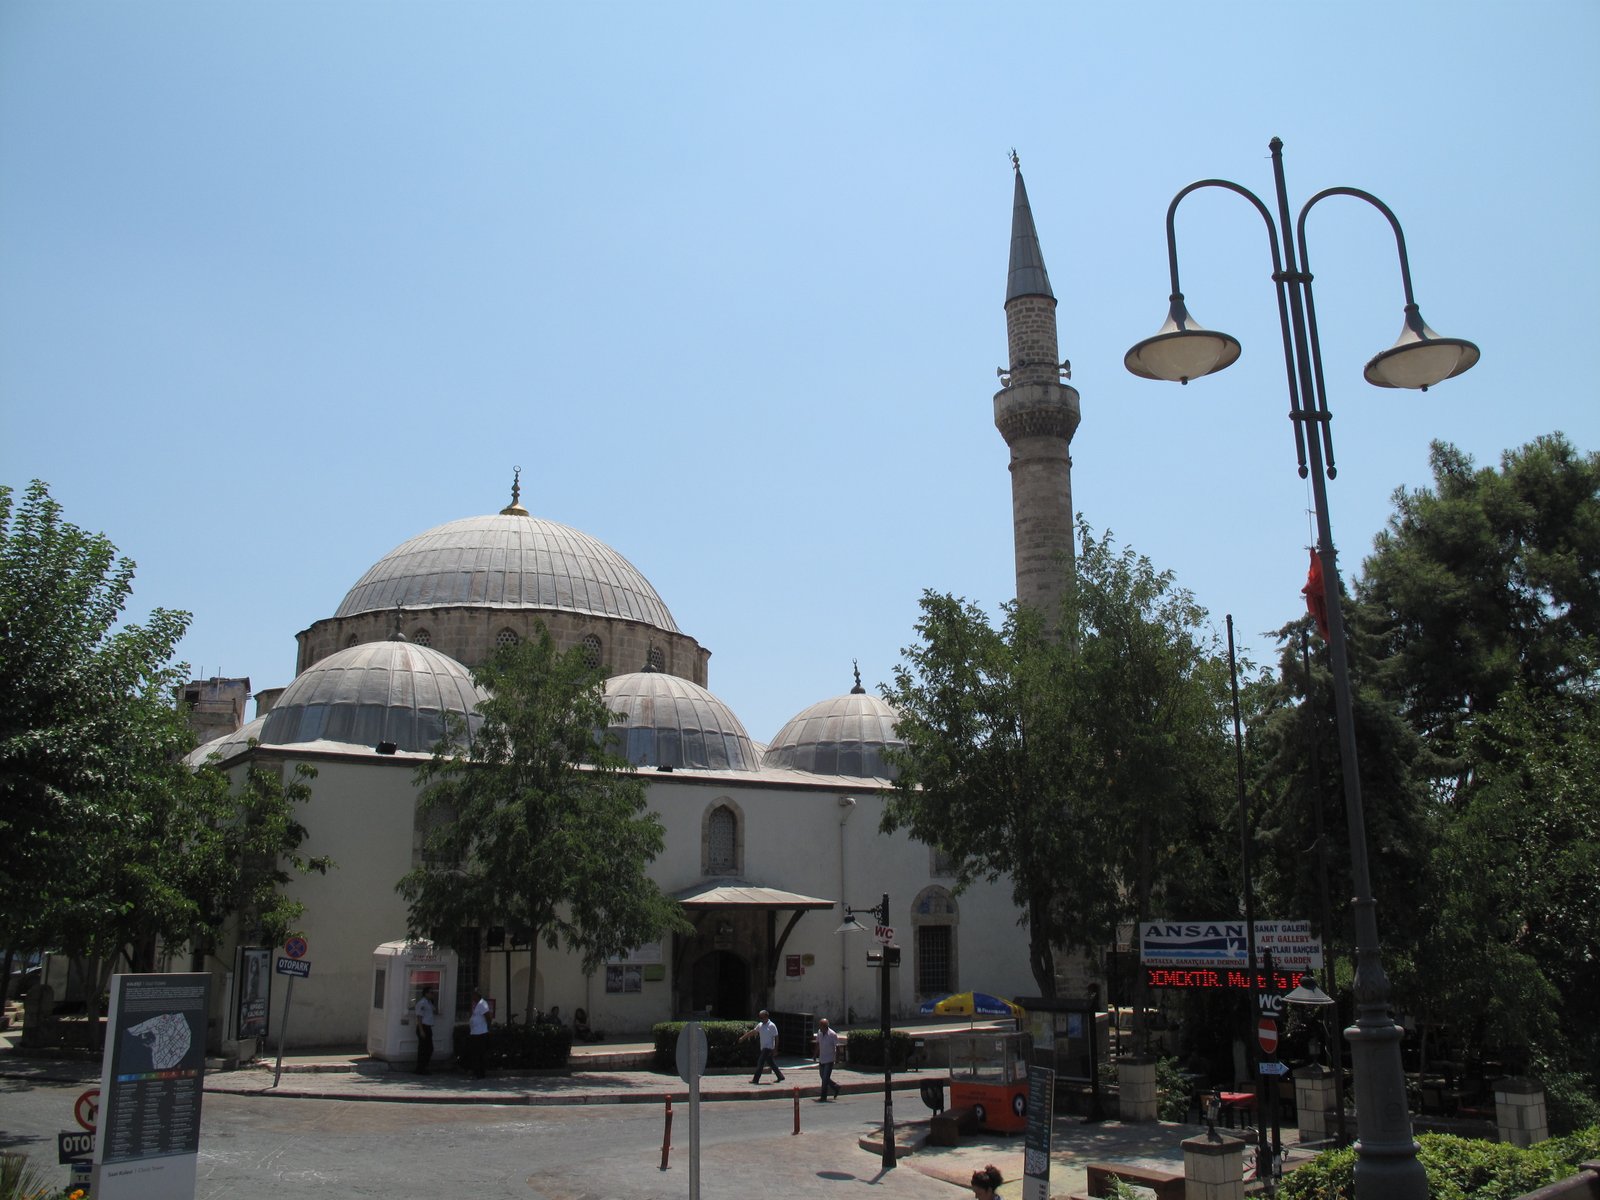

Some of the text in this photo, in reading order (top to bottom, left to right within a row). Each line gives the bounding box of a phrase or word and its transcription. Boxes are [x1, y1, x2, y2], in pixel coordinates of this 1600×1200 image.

[875, 925, 894, 939] WC
[1145, 925, 1243, 937] ANSAN
[1255, 925, 1278, 933] SANAT
[1261, 935, 1310, 943] ART GALLERY
[1256, 943, 1320, 955] SAATLARI BAHÇESİ
[278, 958, 310, 972] OTOPARK
[1284, 956, 1312, 964] GARDEN
[1258, 994, 1282, 1011] WC
